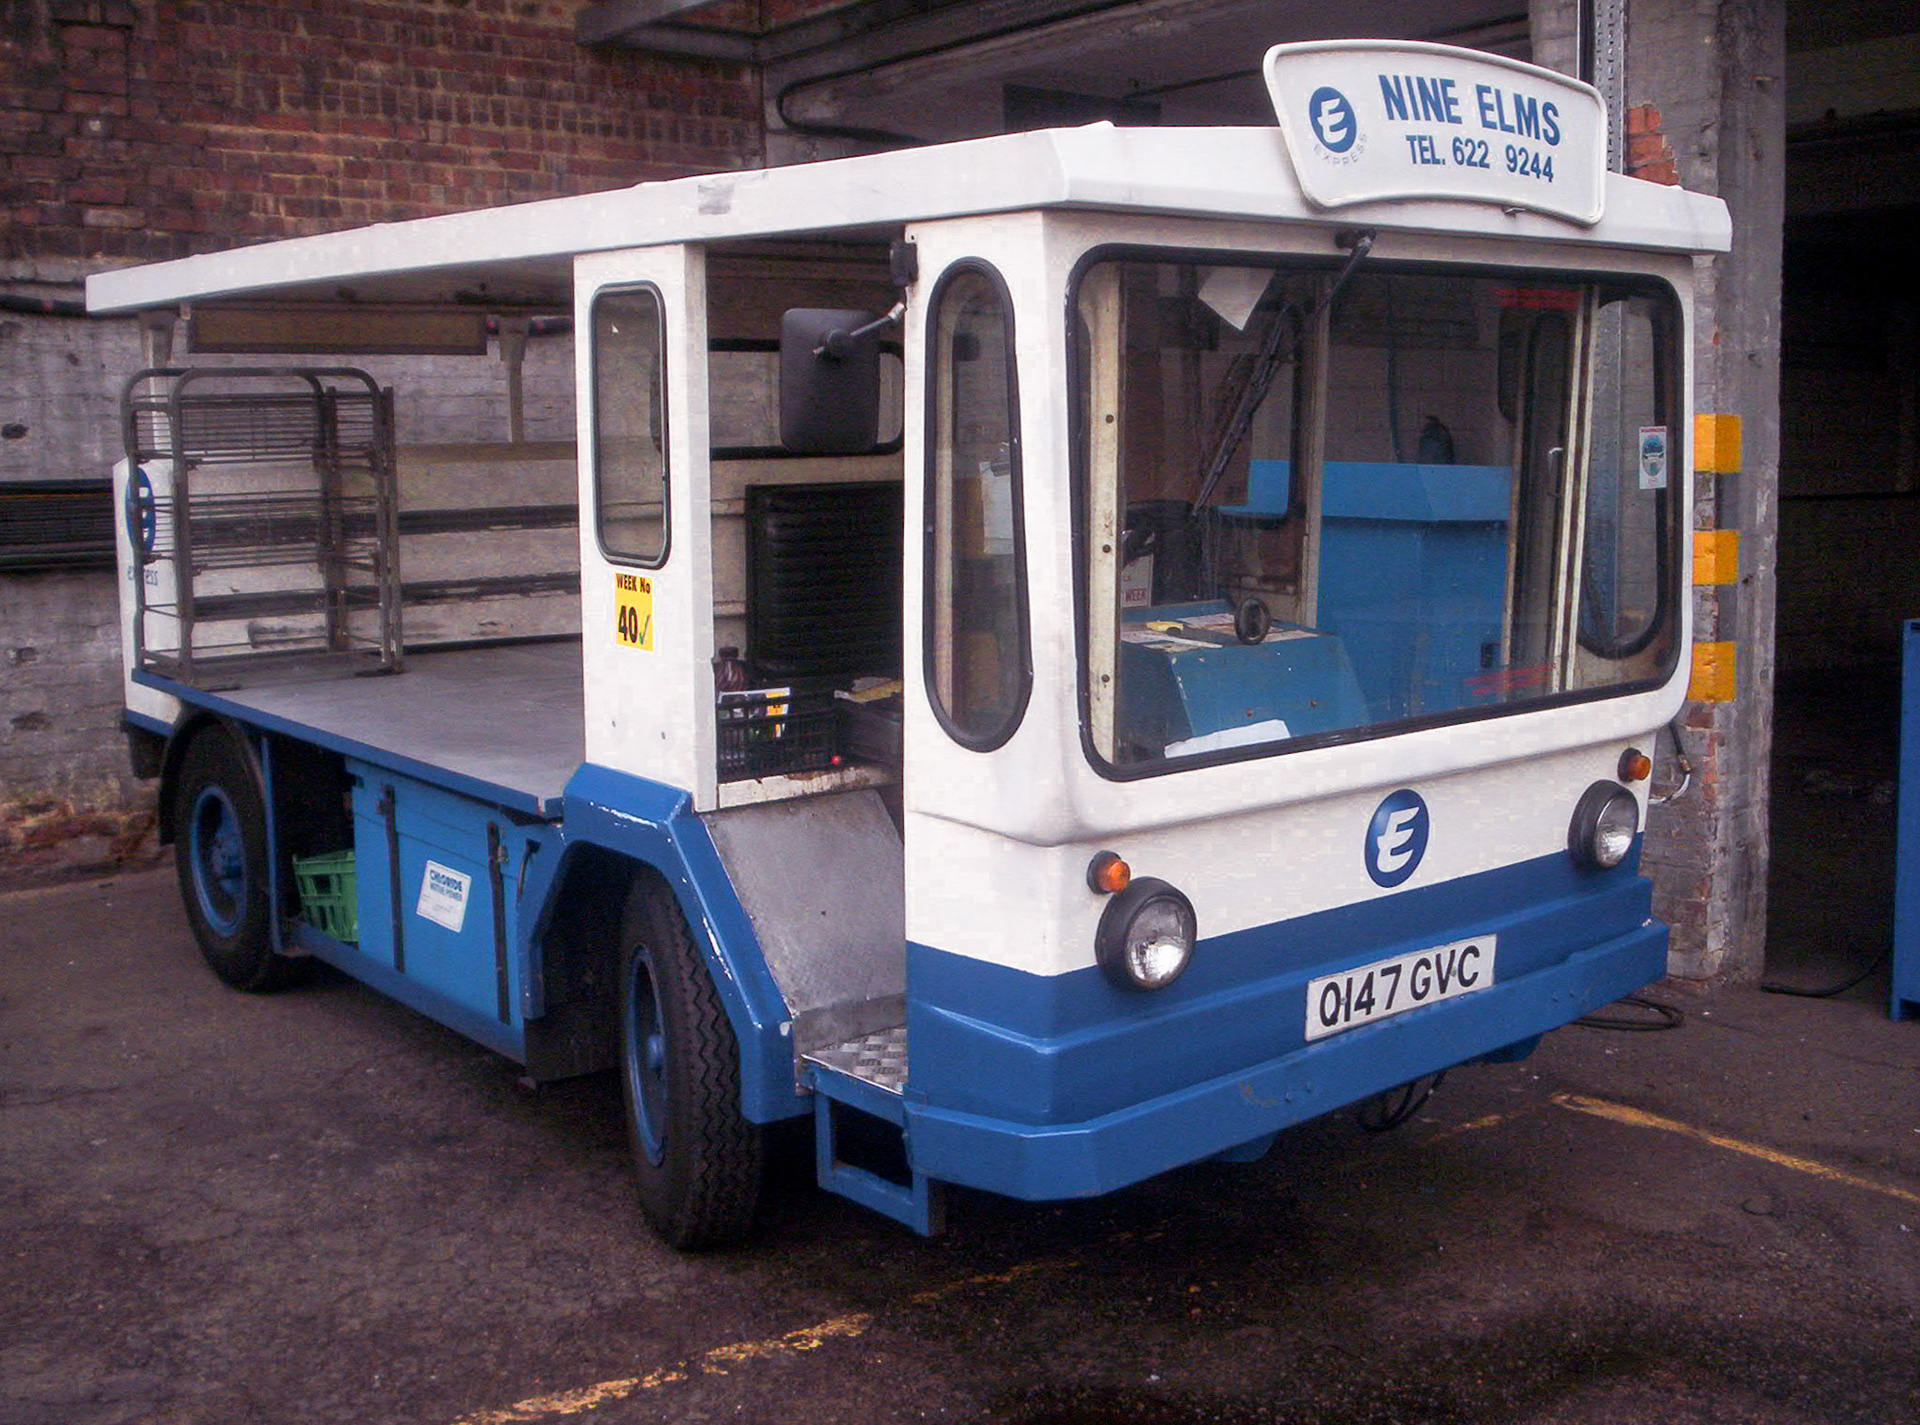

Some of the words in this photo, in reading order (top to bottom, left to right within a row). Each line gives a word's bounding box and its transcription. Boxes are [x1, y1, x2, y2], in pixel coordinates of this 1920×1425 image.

[1378, 74, 1463, 125] NINE
[1475, 84, 1561, 146] ELMS
[1405, 134, 1446, 166] TEL.
[1452, 136, 1490, 169] 622
[1505, 145, 1554, 183] 9244
[615, 573, 638, 593] WEEK
[618, 605, 638, 643] 40
[1319, 963, 1402, 1027] Q147
[1410, 945, 1480, 1001] GVC
